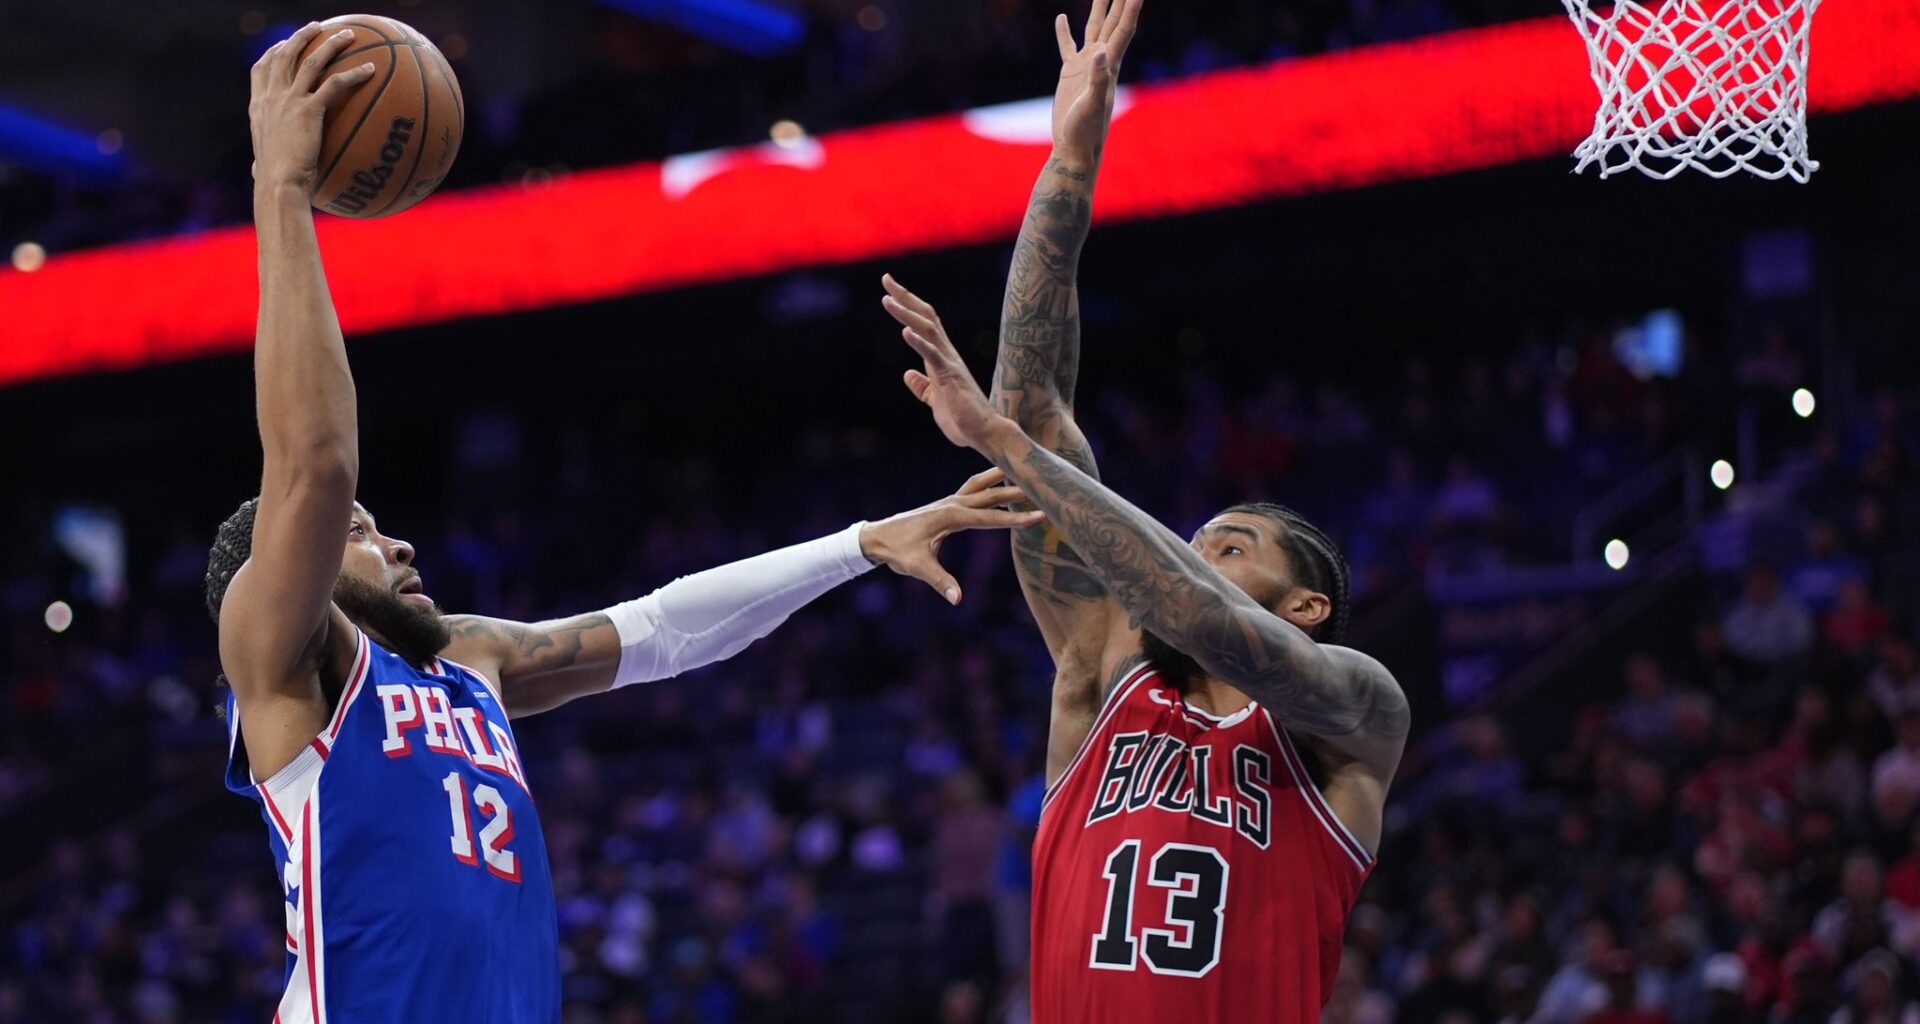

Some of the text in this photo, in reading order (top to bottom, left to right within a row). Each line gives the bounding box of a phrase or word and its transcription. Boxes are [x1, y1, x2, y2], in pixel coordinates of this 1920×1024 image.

[328, 116, 415, 213] Wilson
[376, 684, 533, 799] PHLA
[1085, 730, 1271, 850] BULLS
[443, 772, 521, 882] 12
[1089, 839, 1229, 978] 13
